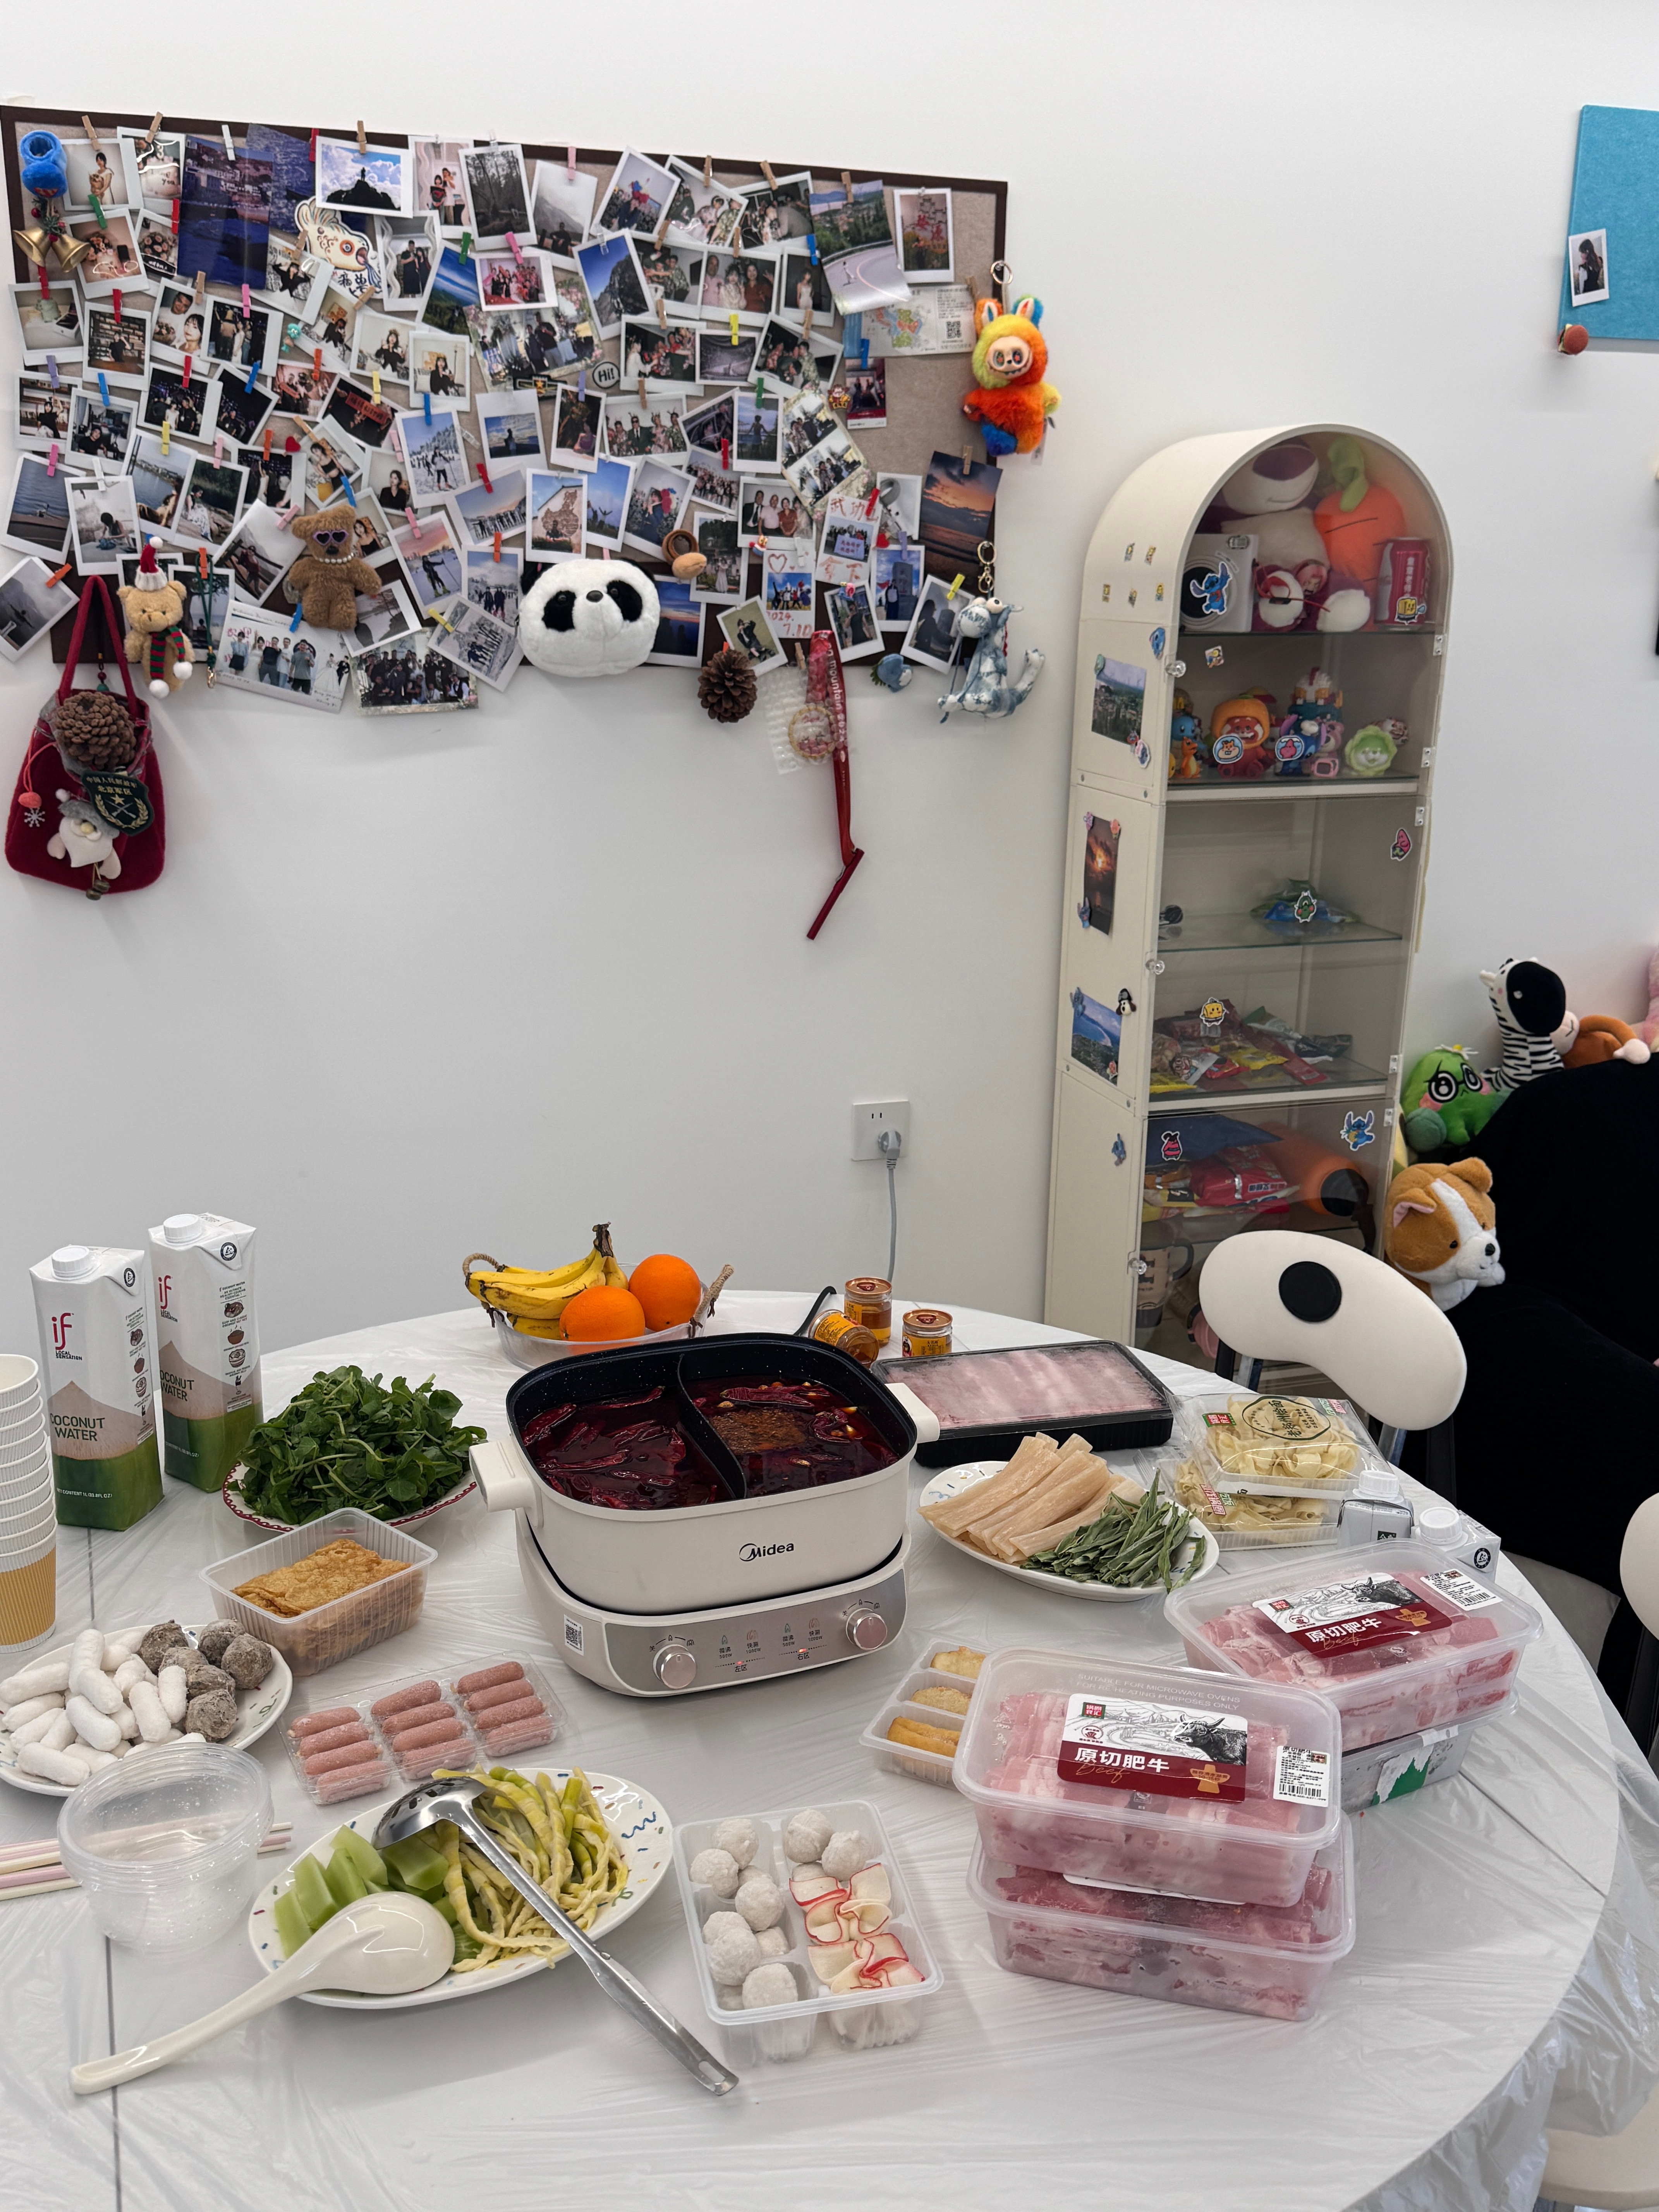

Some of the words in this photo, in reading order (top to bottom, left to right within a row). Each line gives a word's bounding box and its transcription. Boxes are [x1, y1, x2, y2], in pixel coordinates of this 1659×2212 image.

[598, 368, 615, 383] Hi!
[830, 660, 843, 710] mountain
[158, 1275, 172, 1309] if
[52, 1313, 72, 1350] if
[160, 1370, 194, 1390] OCONUT
[161, 1382, 187, 1401] WATER
[50, 1413, 105, 1429] COCONUT
[55, 1427, 98, 1441] WATER
[739, 1543, 794, 1561] Midea
[1305, 1617, 1382, 1643] 原切肥牛
[1322, 1632, 1362, 1650] Beef
[797, 1652, 810, 1660] 右区
[735, 1664, 747, 1673] 左区
[1076, 1681, 1094, 1691] FOR
[1158, 1694, 1211, 1707] PURPOSES
[1213, 1701, 1240, 1711] ONLY
[1078, 1674, 1121, 1686] SUITABLE
[1124, 1680, 1145, 1688] FOR
[1147, 1683, 1204, 1699] MICROWAVE
[1207, 1693, 1241, 1704] OVENS
[1075, 1747, 1170, 1773] 原切肥牛
[1075, 1759, 1130, 1784] Beef
